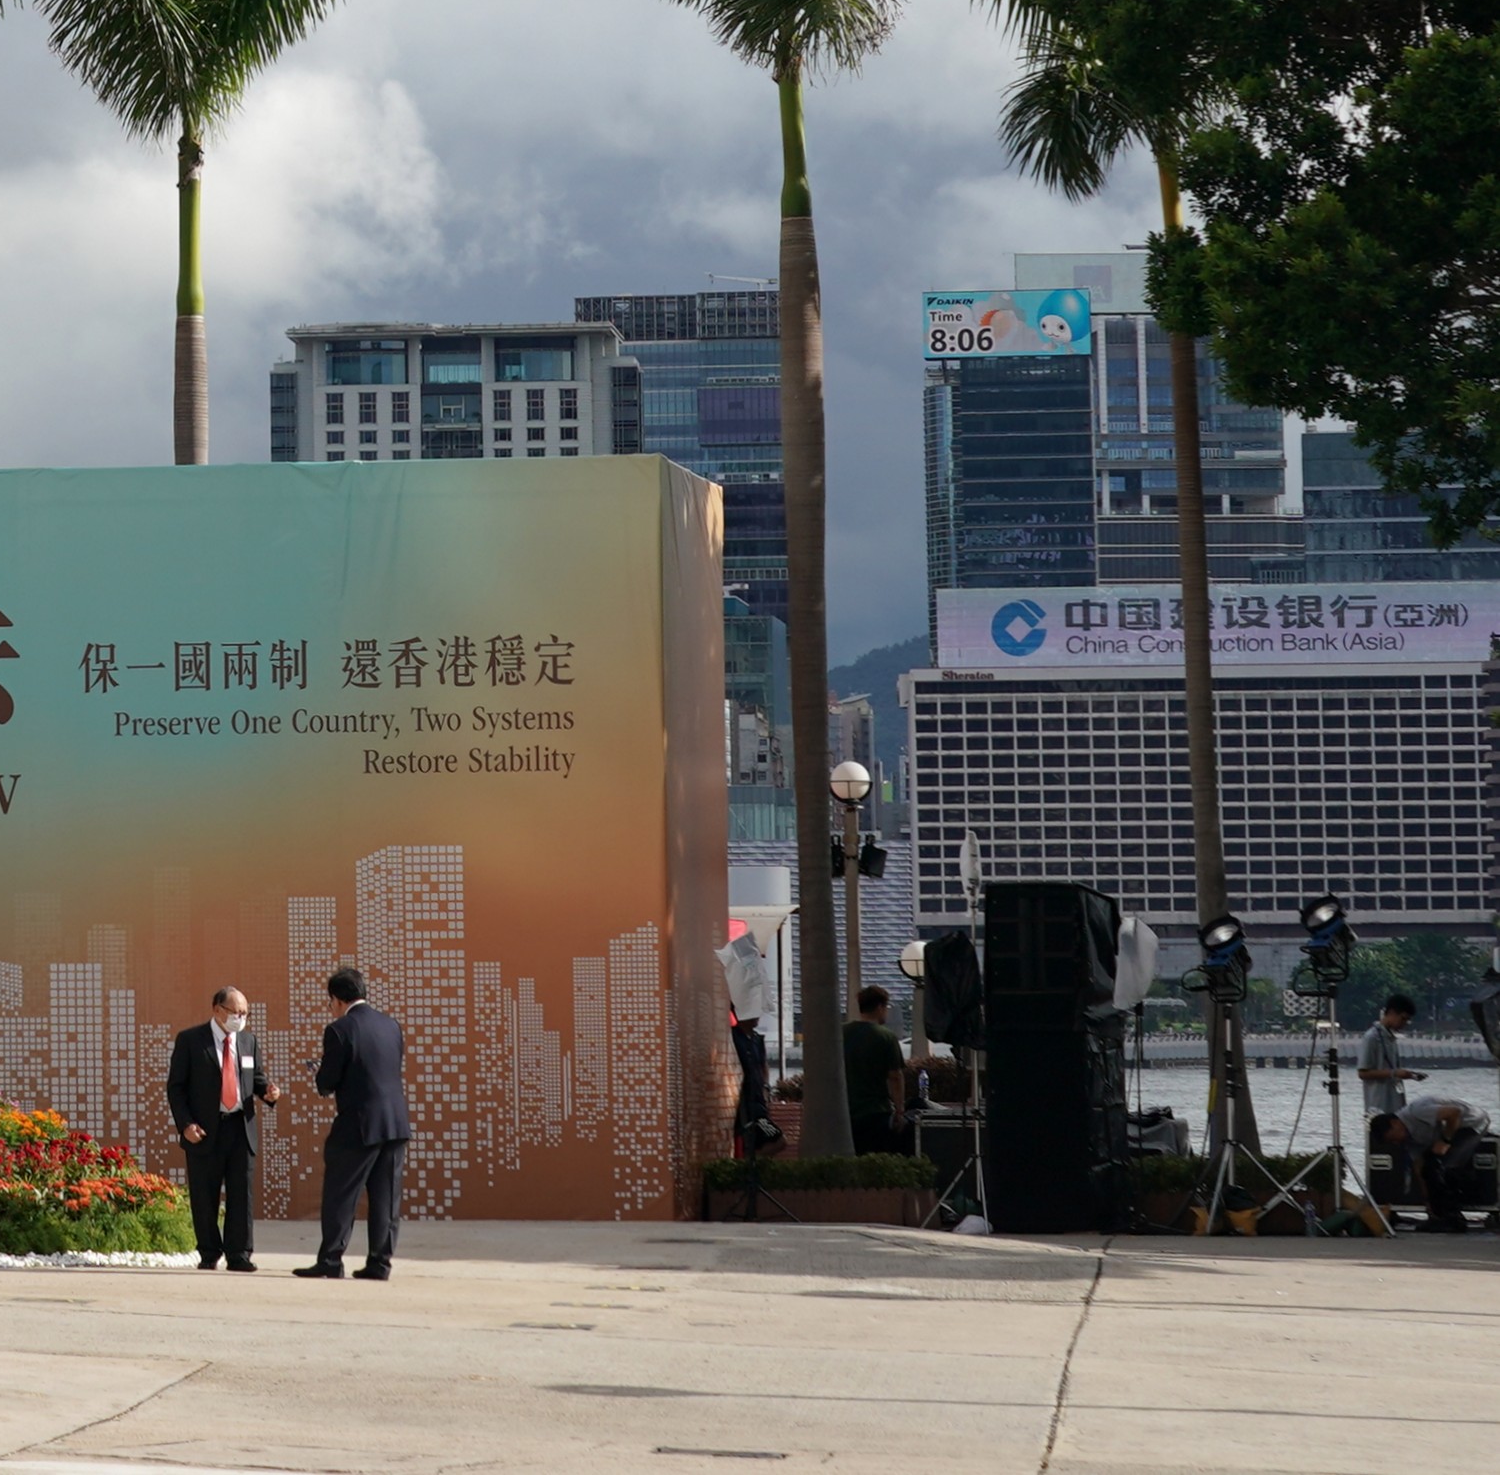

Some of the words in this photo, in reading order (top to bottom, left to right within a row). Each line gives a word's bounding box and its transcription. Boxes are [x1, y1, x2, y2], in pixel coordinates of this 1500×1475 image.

[937, 298, 974, 306] DAIKIN
[930, 311, 962, 322] Time
[930, 328, 994, 352] 8:06
[1066, 634, 1129, 654] China
[1138, 633, 1274, 653] Conuction
[1281, 633, 1338, 651] Bank
[1342, 632, 1405, 651] (Asia)
[78, 639, 308, 693] 保一國兩制
[340, 634, 576, 689] 還香港穩定
[941, 670, 995, 681] Sheraton
[114, 712, 221, 737] Preserve
[231, 709, 281, 735] One
[292, 708, 400, 740] Country,
[411, 706, 461, 732] Two
[472, 705, 575, 738] Systems
[363, 749, 458, 775] Restore
[468, 744, 575, 778] Stability
